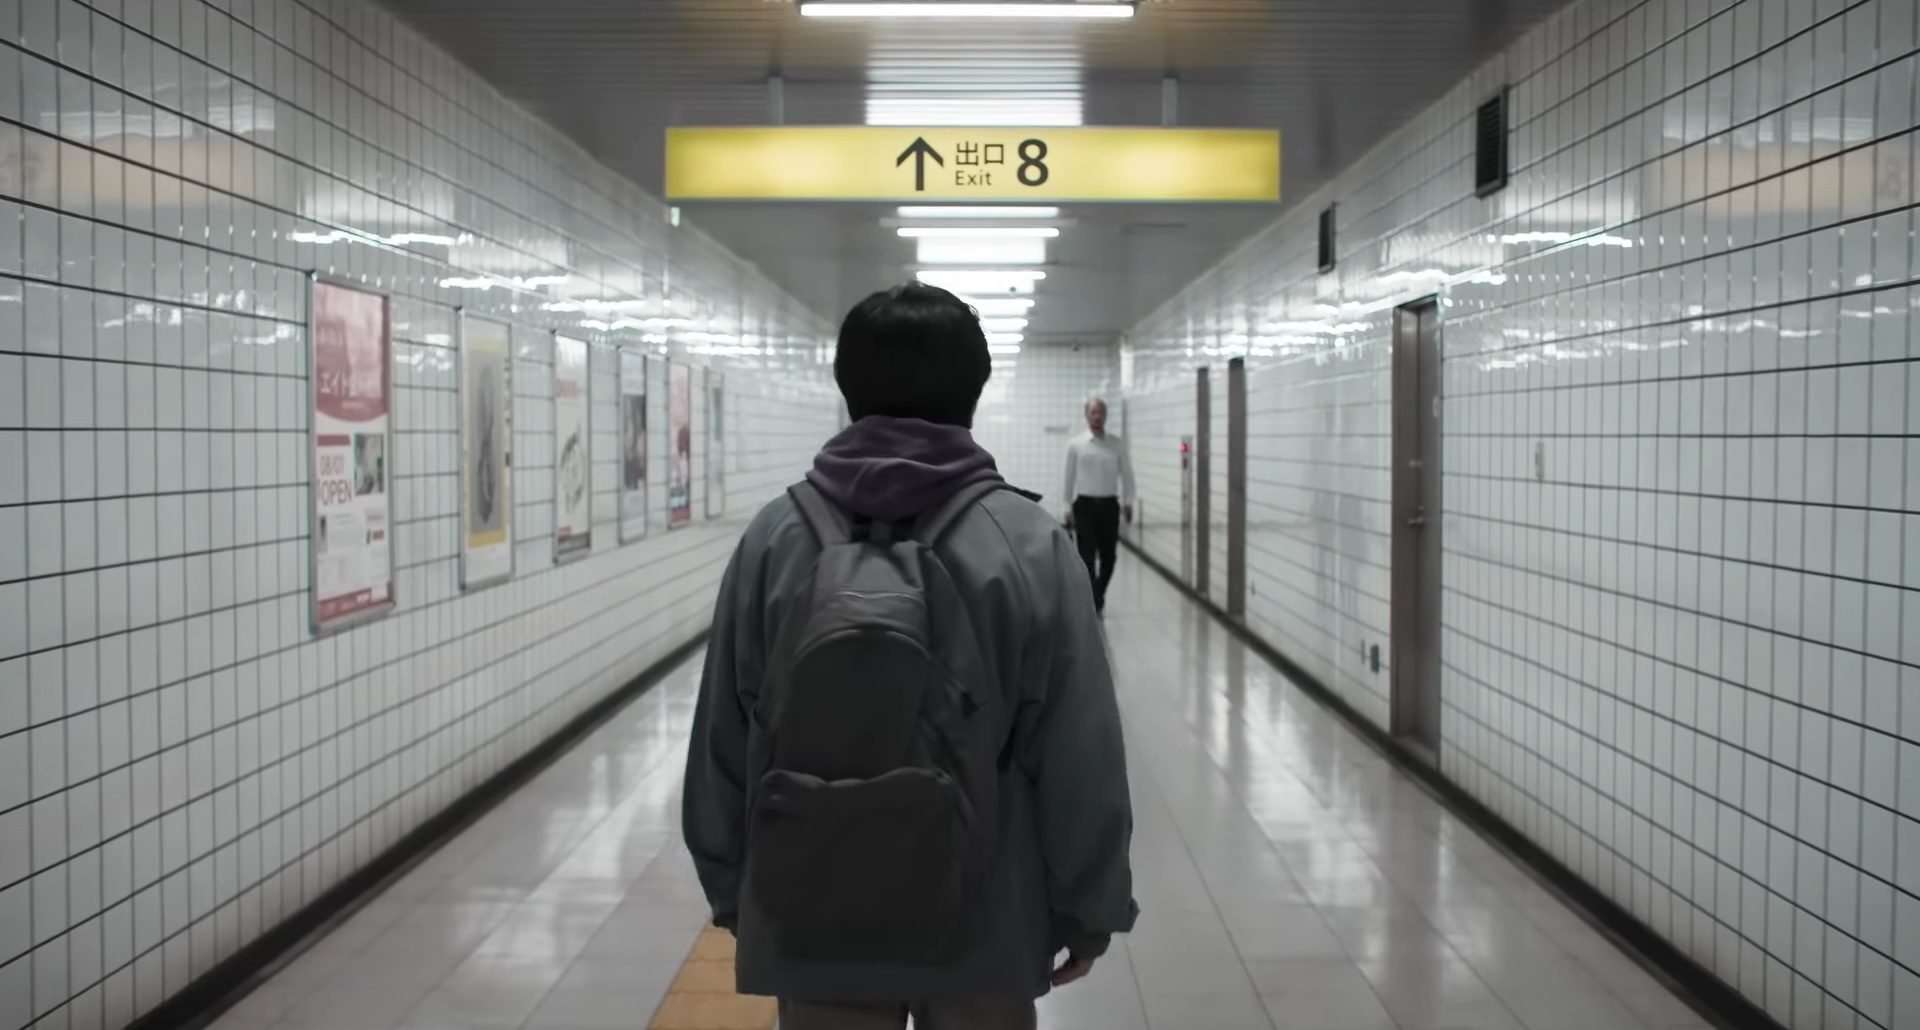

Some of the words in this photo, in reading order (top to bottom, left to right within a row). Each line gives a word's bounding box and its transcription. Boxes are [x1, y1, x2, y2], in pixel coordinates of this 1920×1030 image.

[956, 141, 1004, 166] 出口
[1017, 138, 1049, 187] 8
[955, 169, 992, 186] Exit
